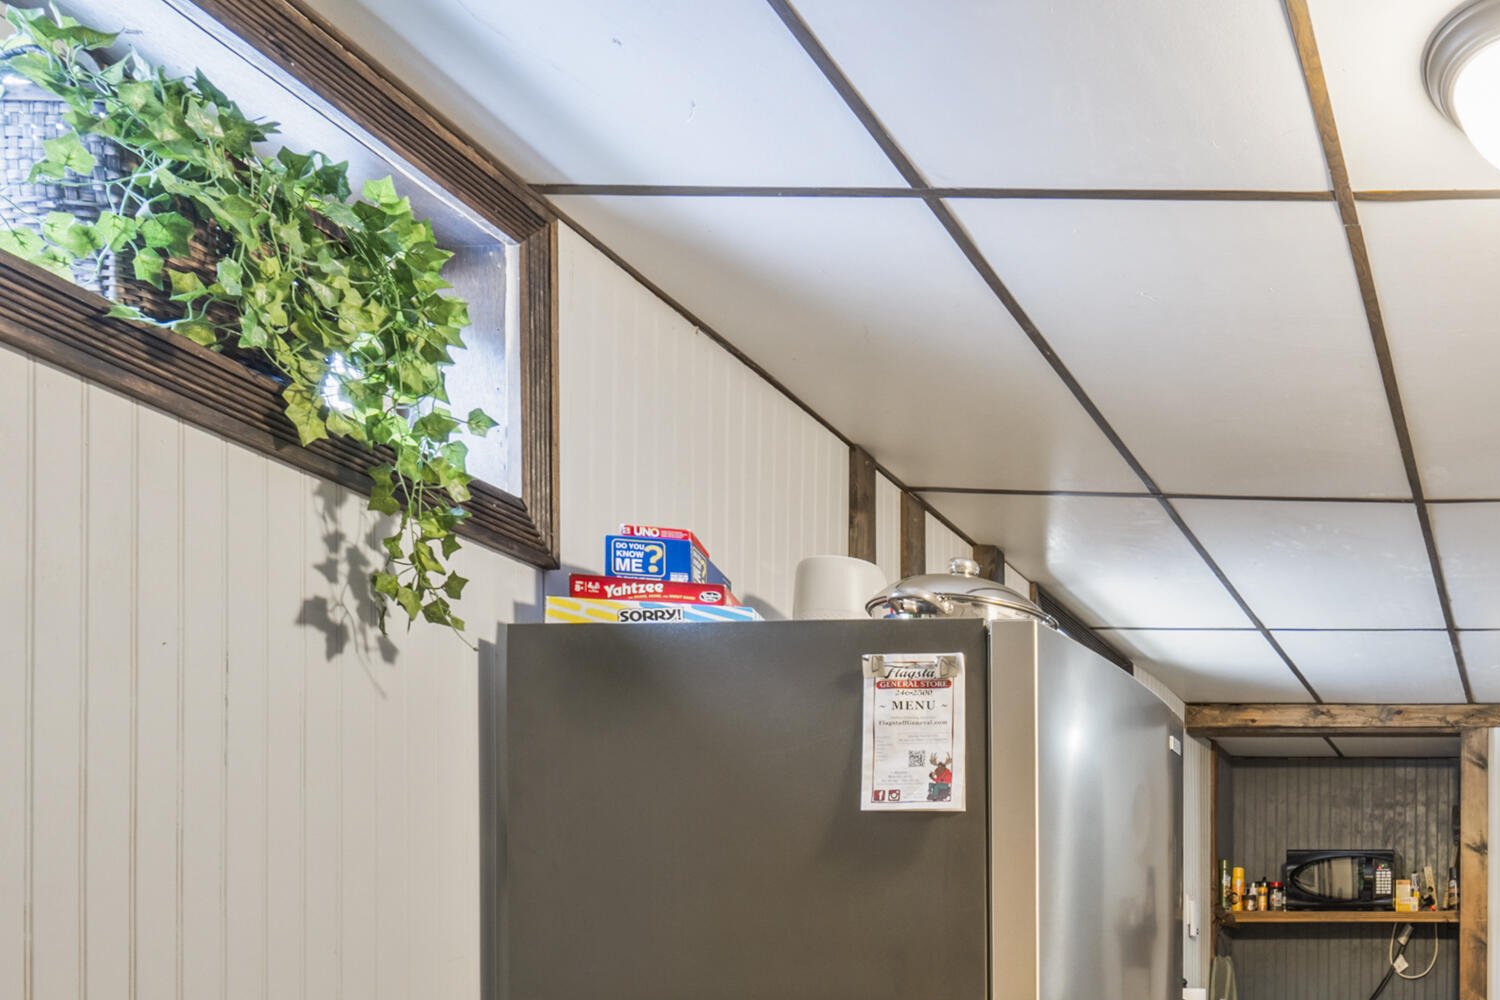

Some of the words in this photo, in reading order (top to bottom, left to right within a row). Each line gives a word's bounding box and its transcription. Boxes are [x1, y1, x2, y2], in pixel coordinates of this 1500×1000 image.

[634, 527, 660, 538] UNO
[615, 550, 645, 558] KNOW
[604, 583, 664, 598] Yahtzee
[620, 608, 681, 622] SORRY!
[884, 664, 937, 680] Flagsta
[892, 700, 936, 710] MENU
